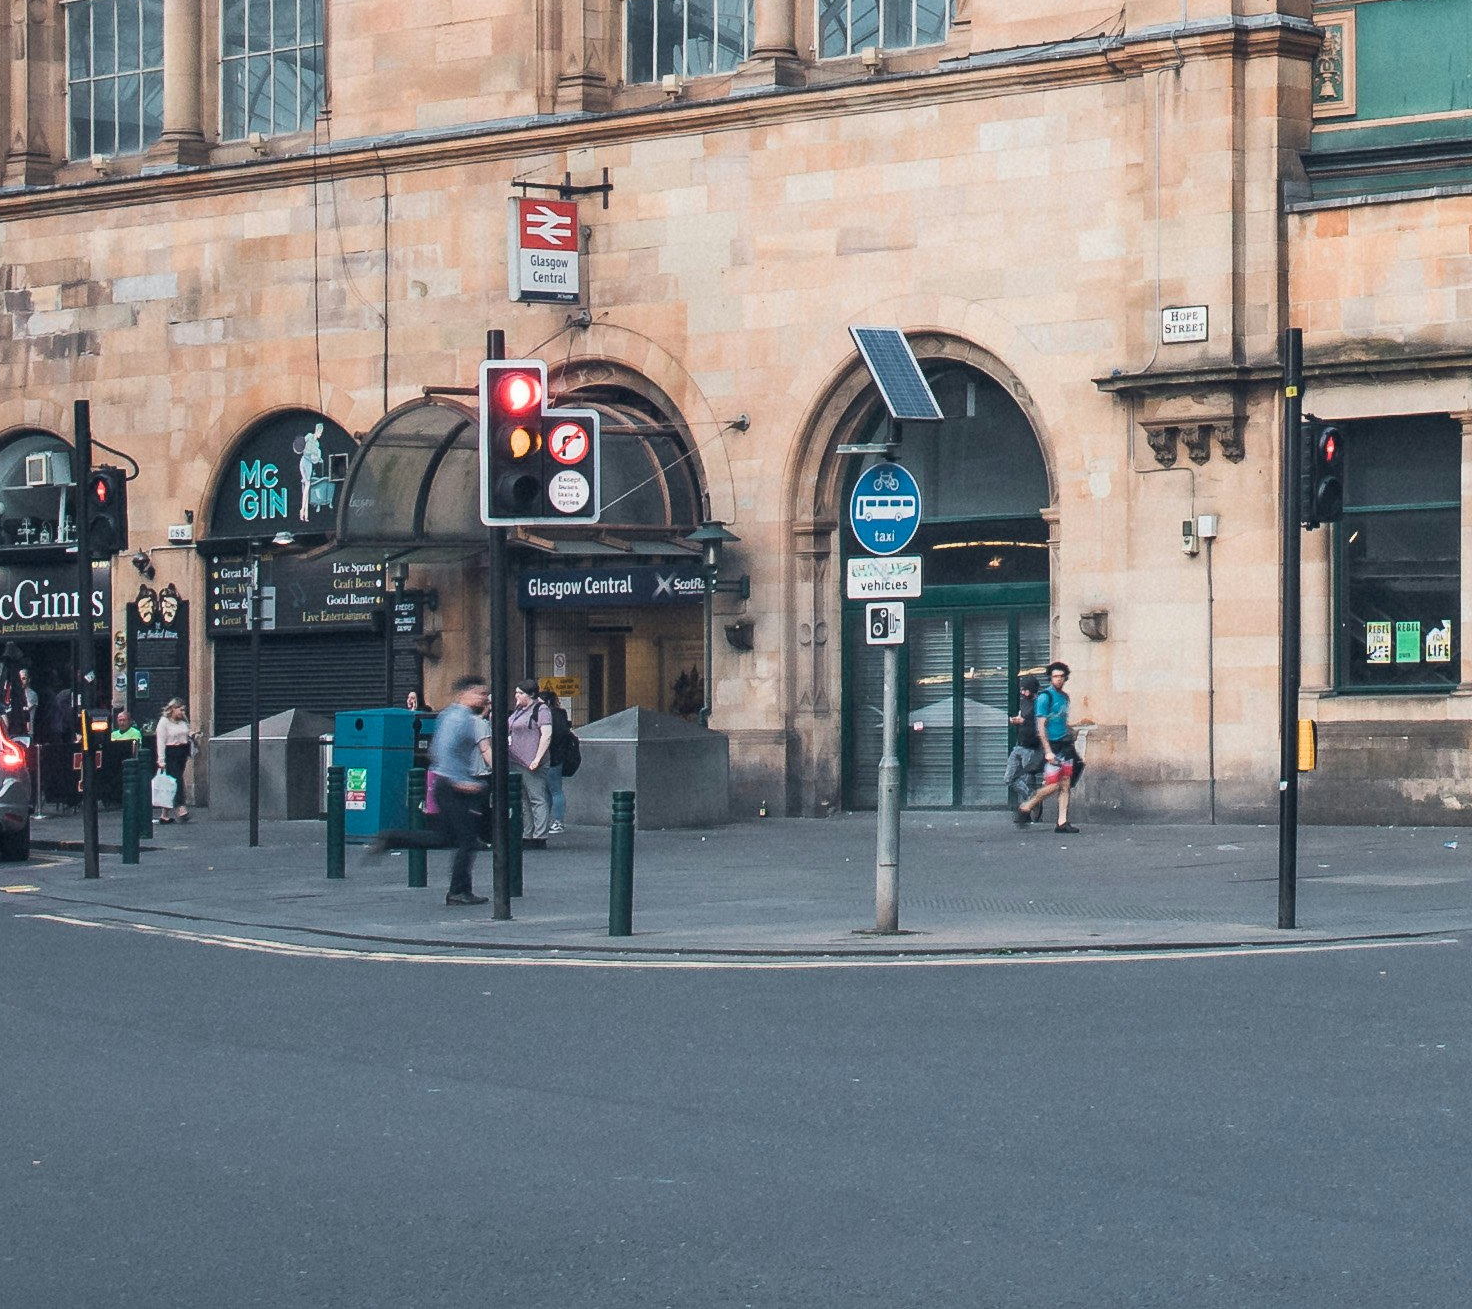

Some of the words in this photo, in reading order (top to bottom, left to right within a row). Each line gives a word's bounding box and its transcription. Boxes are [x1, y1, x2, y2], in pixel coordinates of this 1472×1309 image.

[530, 254, 569, 270] Glasgow
[533, 270, 567, 284] Central
[1171, 311, 1198, 321] HOPE
[1164, 323, 1204, 334] STREET
[239, 487, 288, 521] GIN
[874, 529, 896, 542] taxi
[221, 569, 241, 579] Great
[332, 562, 350, 573] Live
[351, 562, 376, 575] Sports
[333, 578, 354, 589] Craft
[355, 577, 375, 588] Beers
[528, 577, 582, 600] Glasgow
[584, 574, 633, 595] Central
[673, 577, 706, 590] ScotRa
[860, 579, 908, 591] vehicles
[220, 599, 240, 610] Wine
[326, 594, 349, 605] Good
[350, 594, 376, 605] Banter
[221, 615, 241, 625] Great
[302, 611, 319, 622] Live
[321, 611, 372, 622] Entertainmen
[2, 622, 14, 634] just
[15, 622, 38, 632] friends
[39, 622, 53, 631] who
[54, 621, 78, 631] haven't
[1368, 624, 1390, 633] REBEL
[1397, 623, 1419, 631] REBEL
[1427, 644, 1449, 657] LIFE
